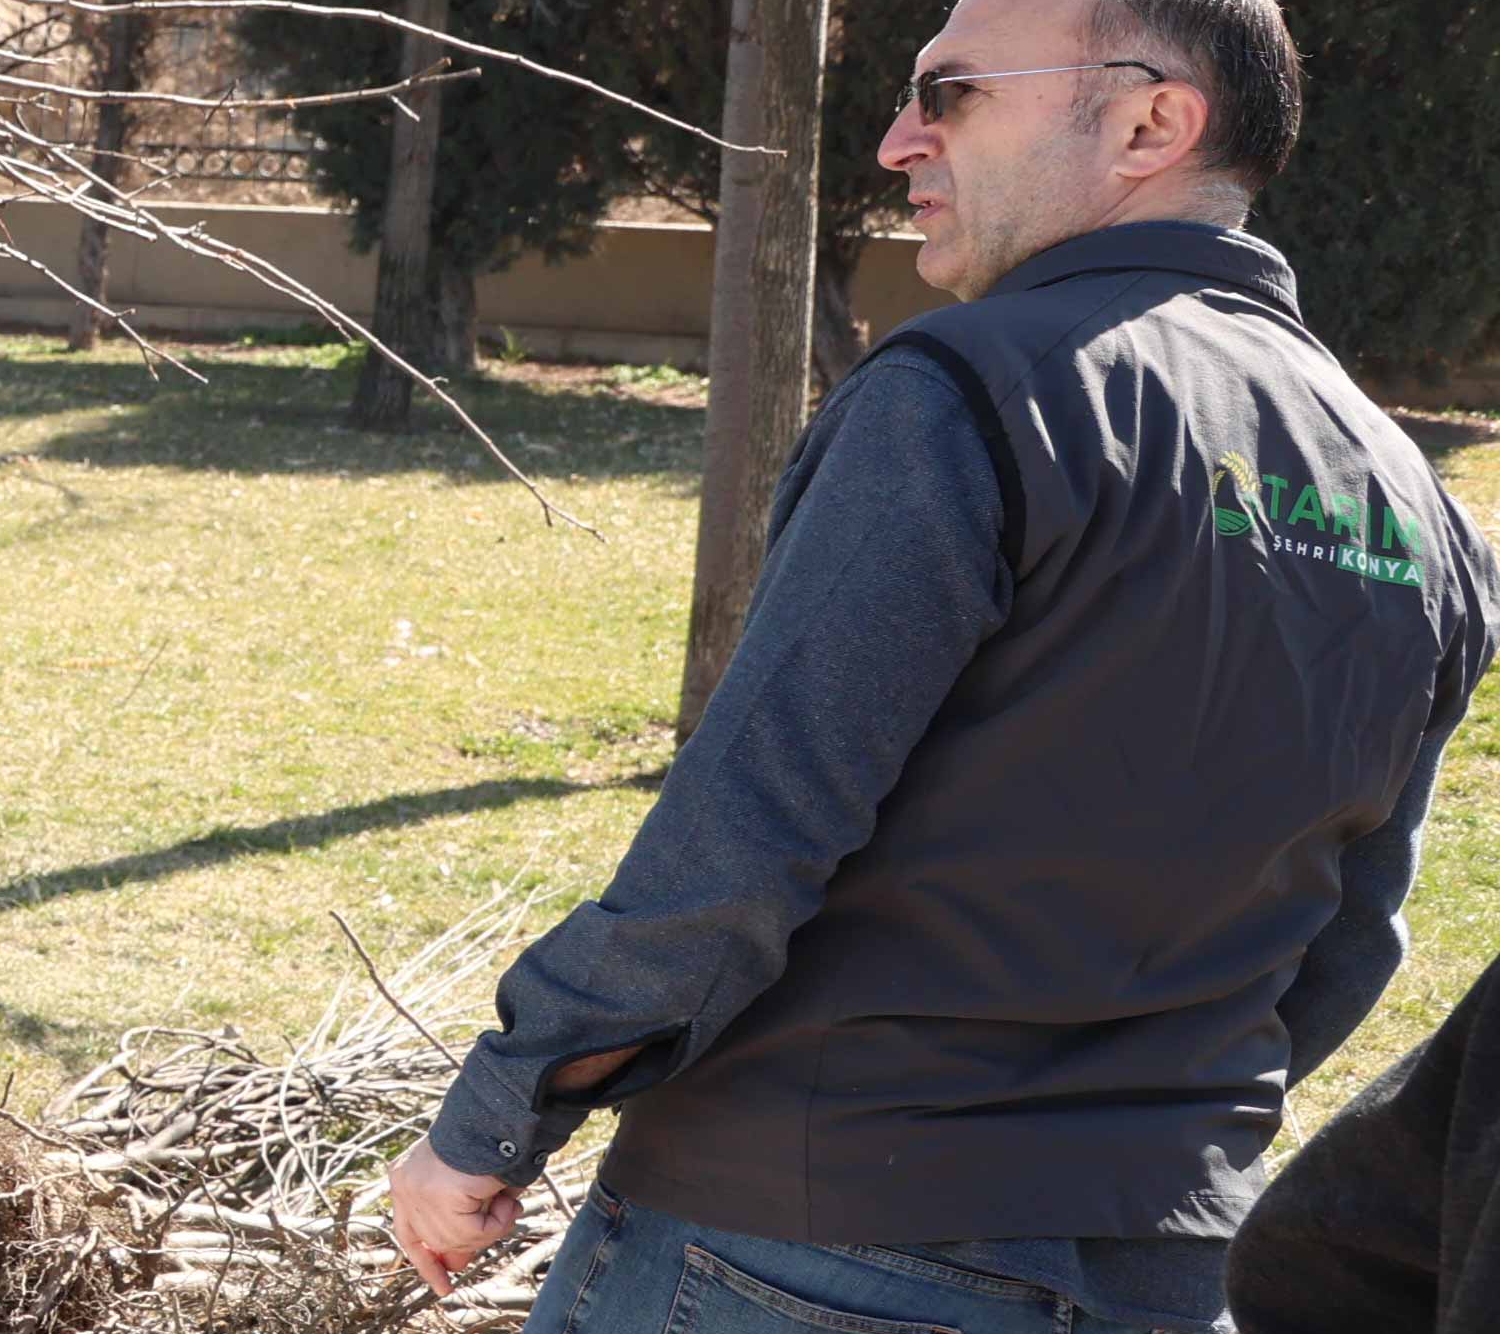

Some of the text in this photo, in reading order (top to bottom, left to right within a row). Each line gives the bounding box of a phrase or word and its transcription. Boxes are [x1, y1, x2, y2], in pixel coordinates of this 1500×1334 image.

[1262, 473, 1422, 555] TARIM
[1272, 534, 1422, 583] ŞEHRİ KONYA
